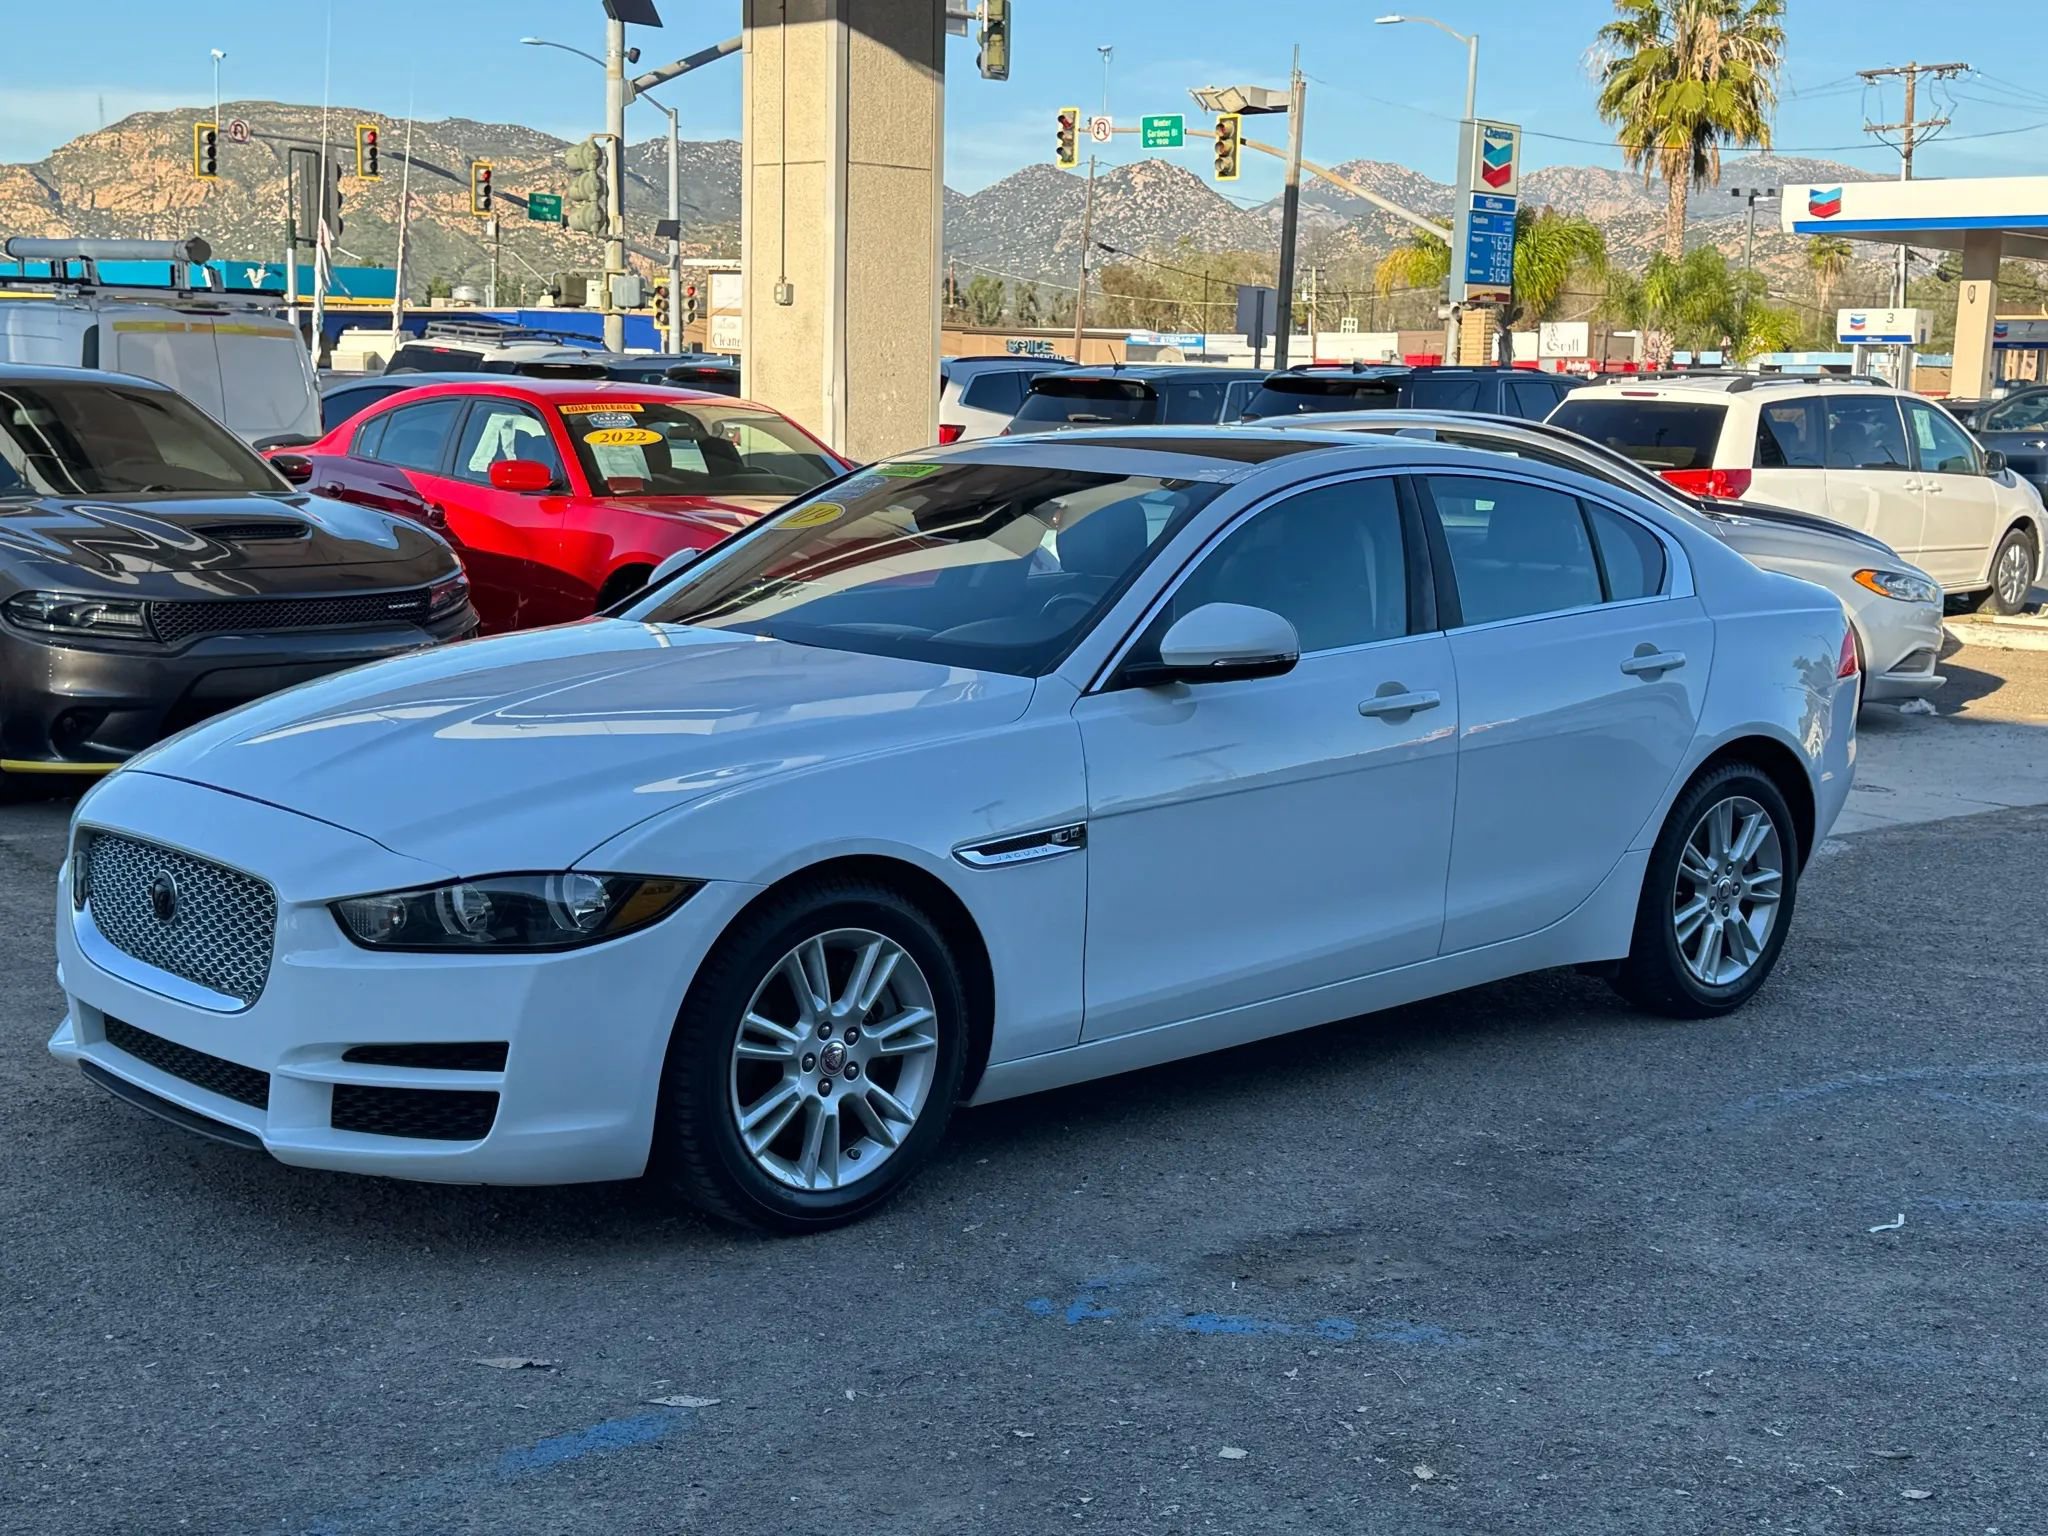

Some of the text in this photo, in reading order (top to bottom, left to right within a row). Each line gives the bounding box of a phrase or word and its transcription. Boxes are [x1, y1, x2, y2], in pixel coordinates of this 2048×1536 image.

[1886, 312, 1895, 323] 3
[2026, 321, 2034, 331] 7
[565, 403, 637, 413] LOW MILEAGE
[599, 431, 647, 444] 2022
[996, 847, 1049, 861] JAGUAR
